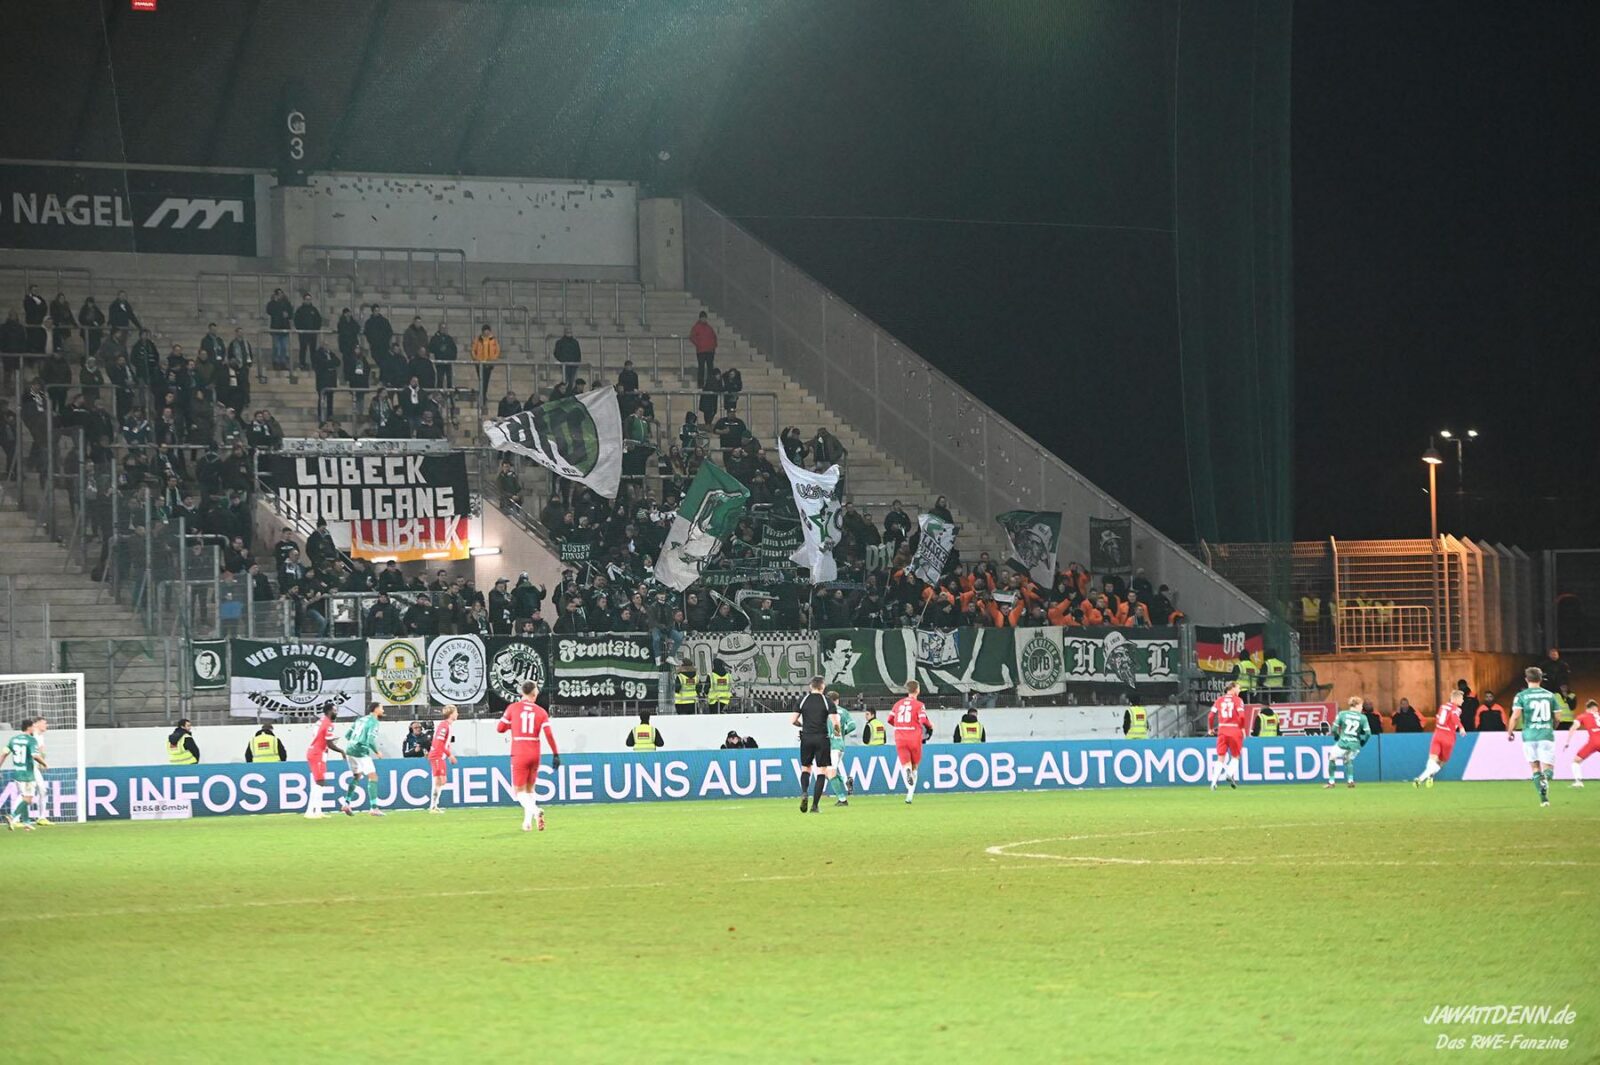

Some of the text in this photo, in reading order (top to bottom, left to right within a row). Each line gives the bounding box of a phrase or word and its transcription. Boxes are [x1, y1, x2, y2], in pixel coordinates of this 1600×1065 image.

[290, 136, 304, 160] 3
[12, 192, 134, 227] NAGEL
[278, 486, 455, 520] HOOLIGANS
[245, 647, 278, 668] VfB
[281, 644, 358, 668] FANCLUB
[558, 639, 650, 663] Frontside
[1069, 639, 1099, 675] H
[1147, 643, 1172, 677] L
[558, 677, 616, 699] Lübeck
[519, 711, 536, 734] 11
[1529, 699, 1552, 722] 20
[1343, 718, 1361, 736] 22
[129, 773, 266, 812] INFOS
[279, 767, 520, 811] BESUCHEN
[535, 763, 594, 802] SIE
[604, 759, 690, 799] UNS
[699, 758, 782, 796] AUF
